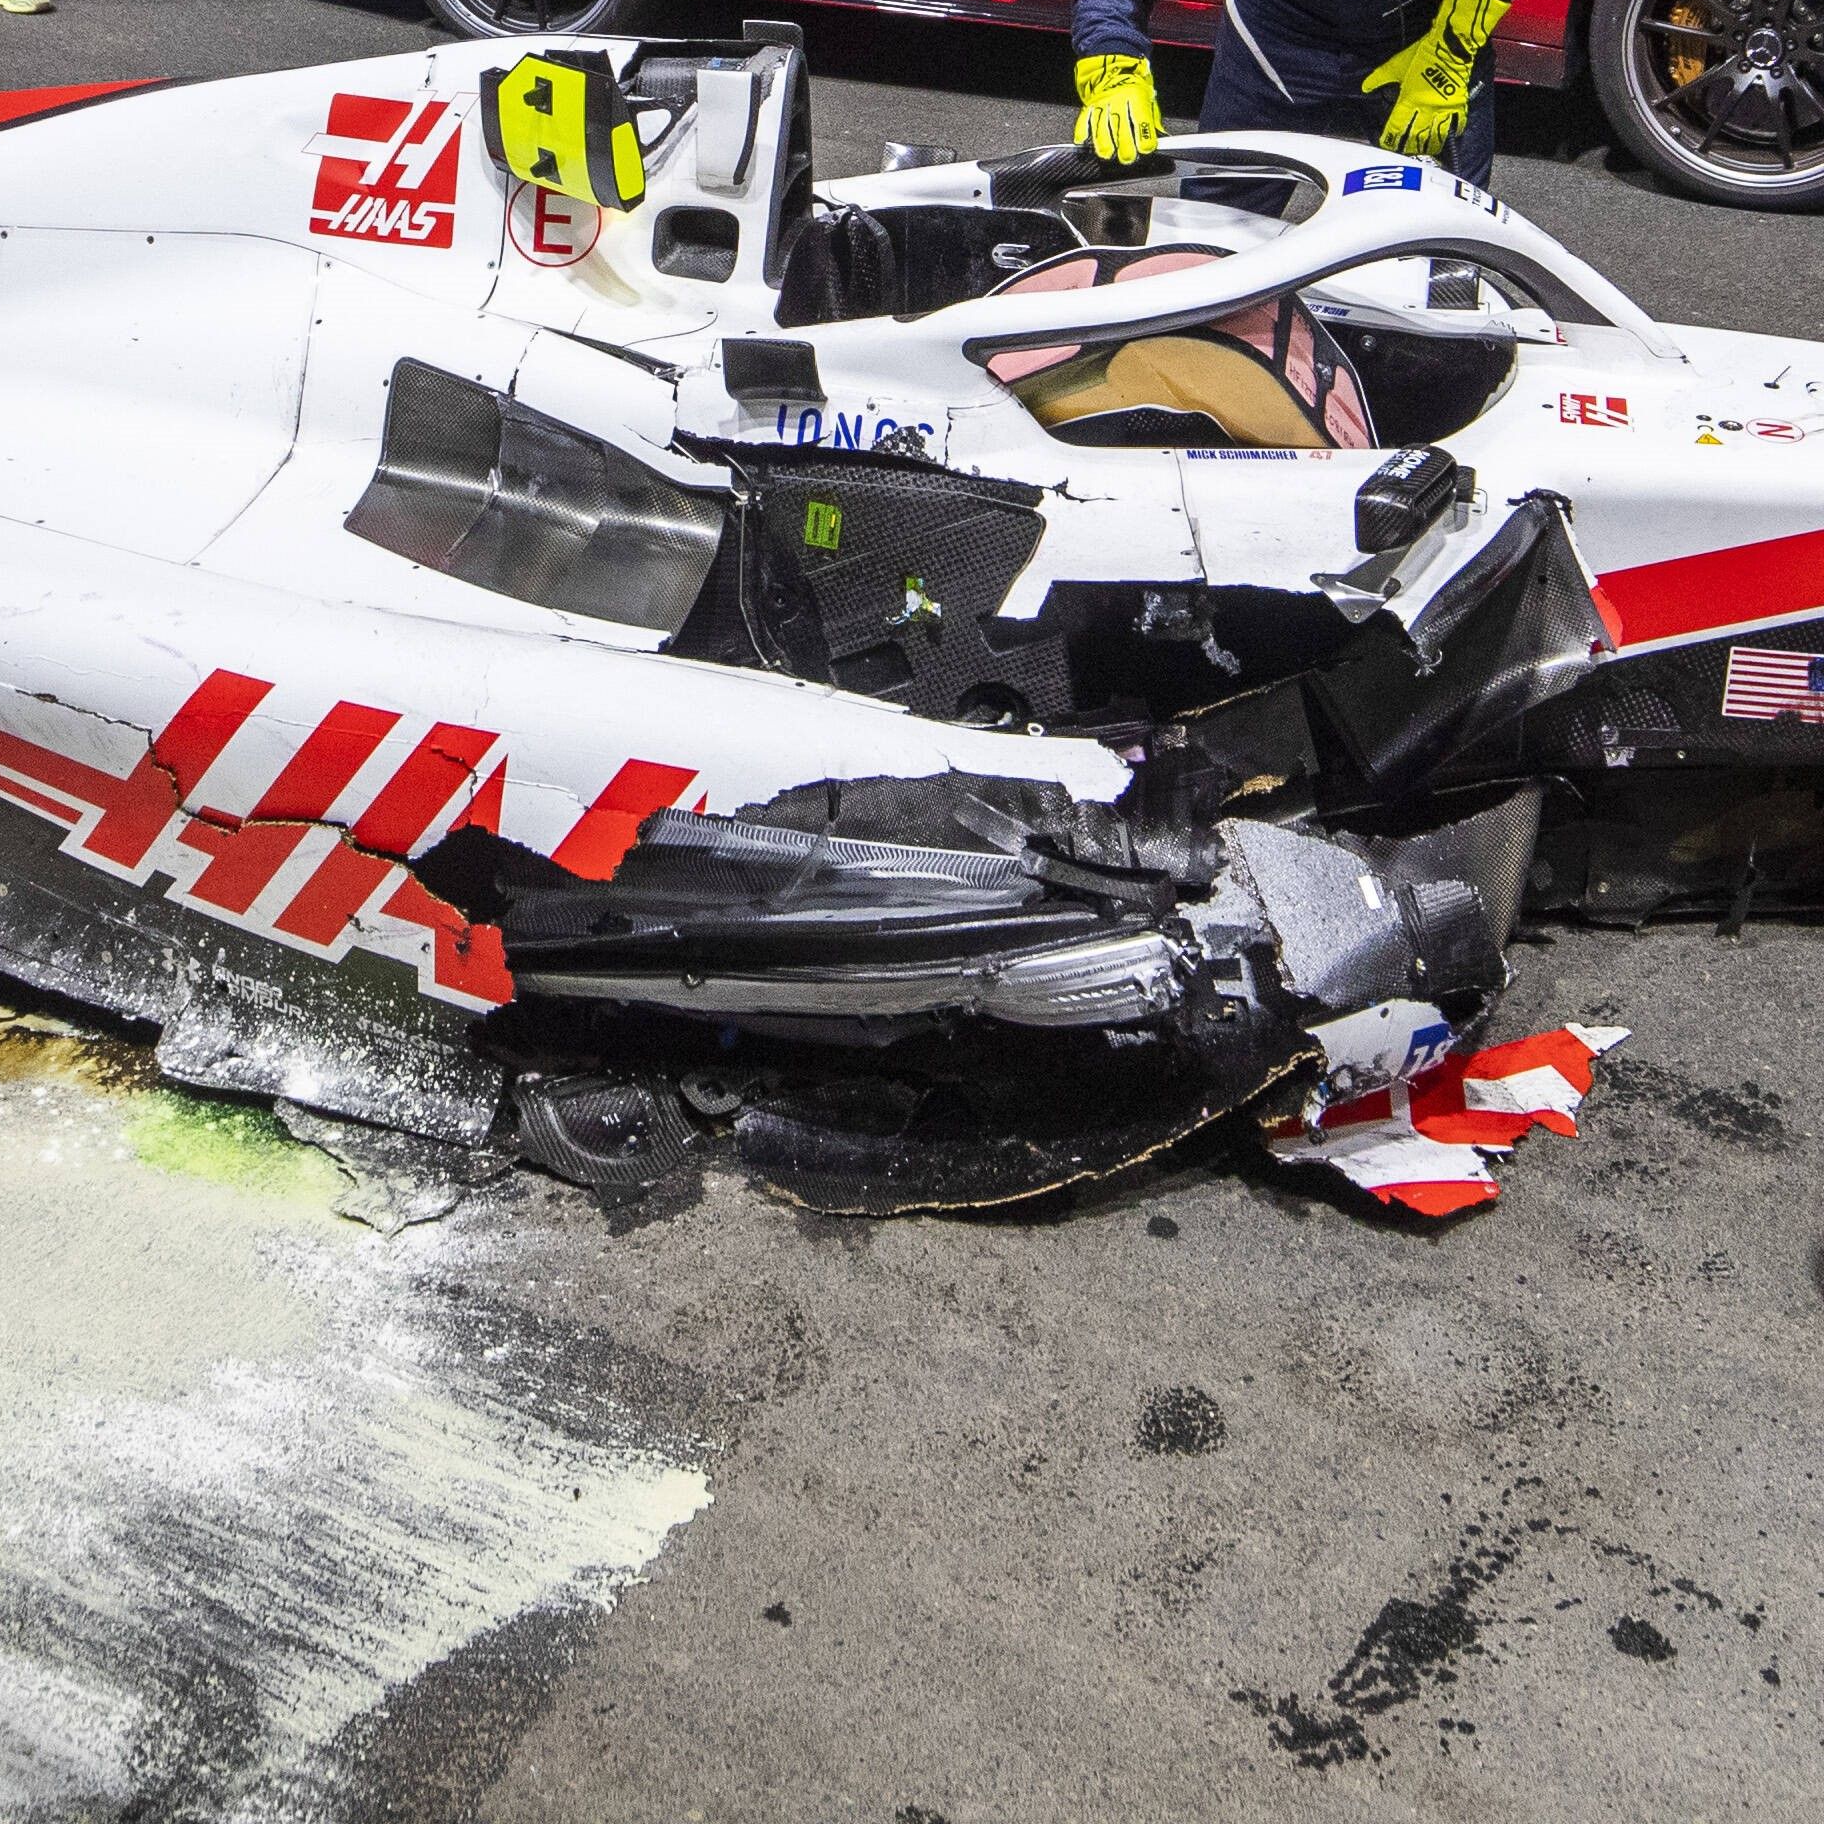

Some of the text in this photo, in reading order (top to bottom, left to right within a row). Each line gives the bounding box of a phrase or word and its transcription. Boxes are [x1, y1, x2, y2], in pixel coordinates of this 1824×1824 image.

[1423, 66, 1457, 97] OMP
[310, 193, 457, 240] HAAS
[534, 184, 573, 255] E
[1187, 449, 1217, 461] MICK
[1219, 449, 1298, 461] SCHUMACHER
